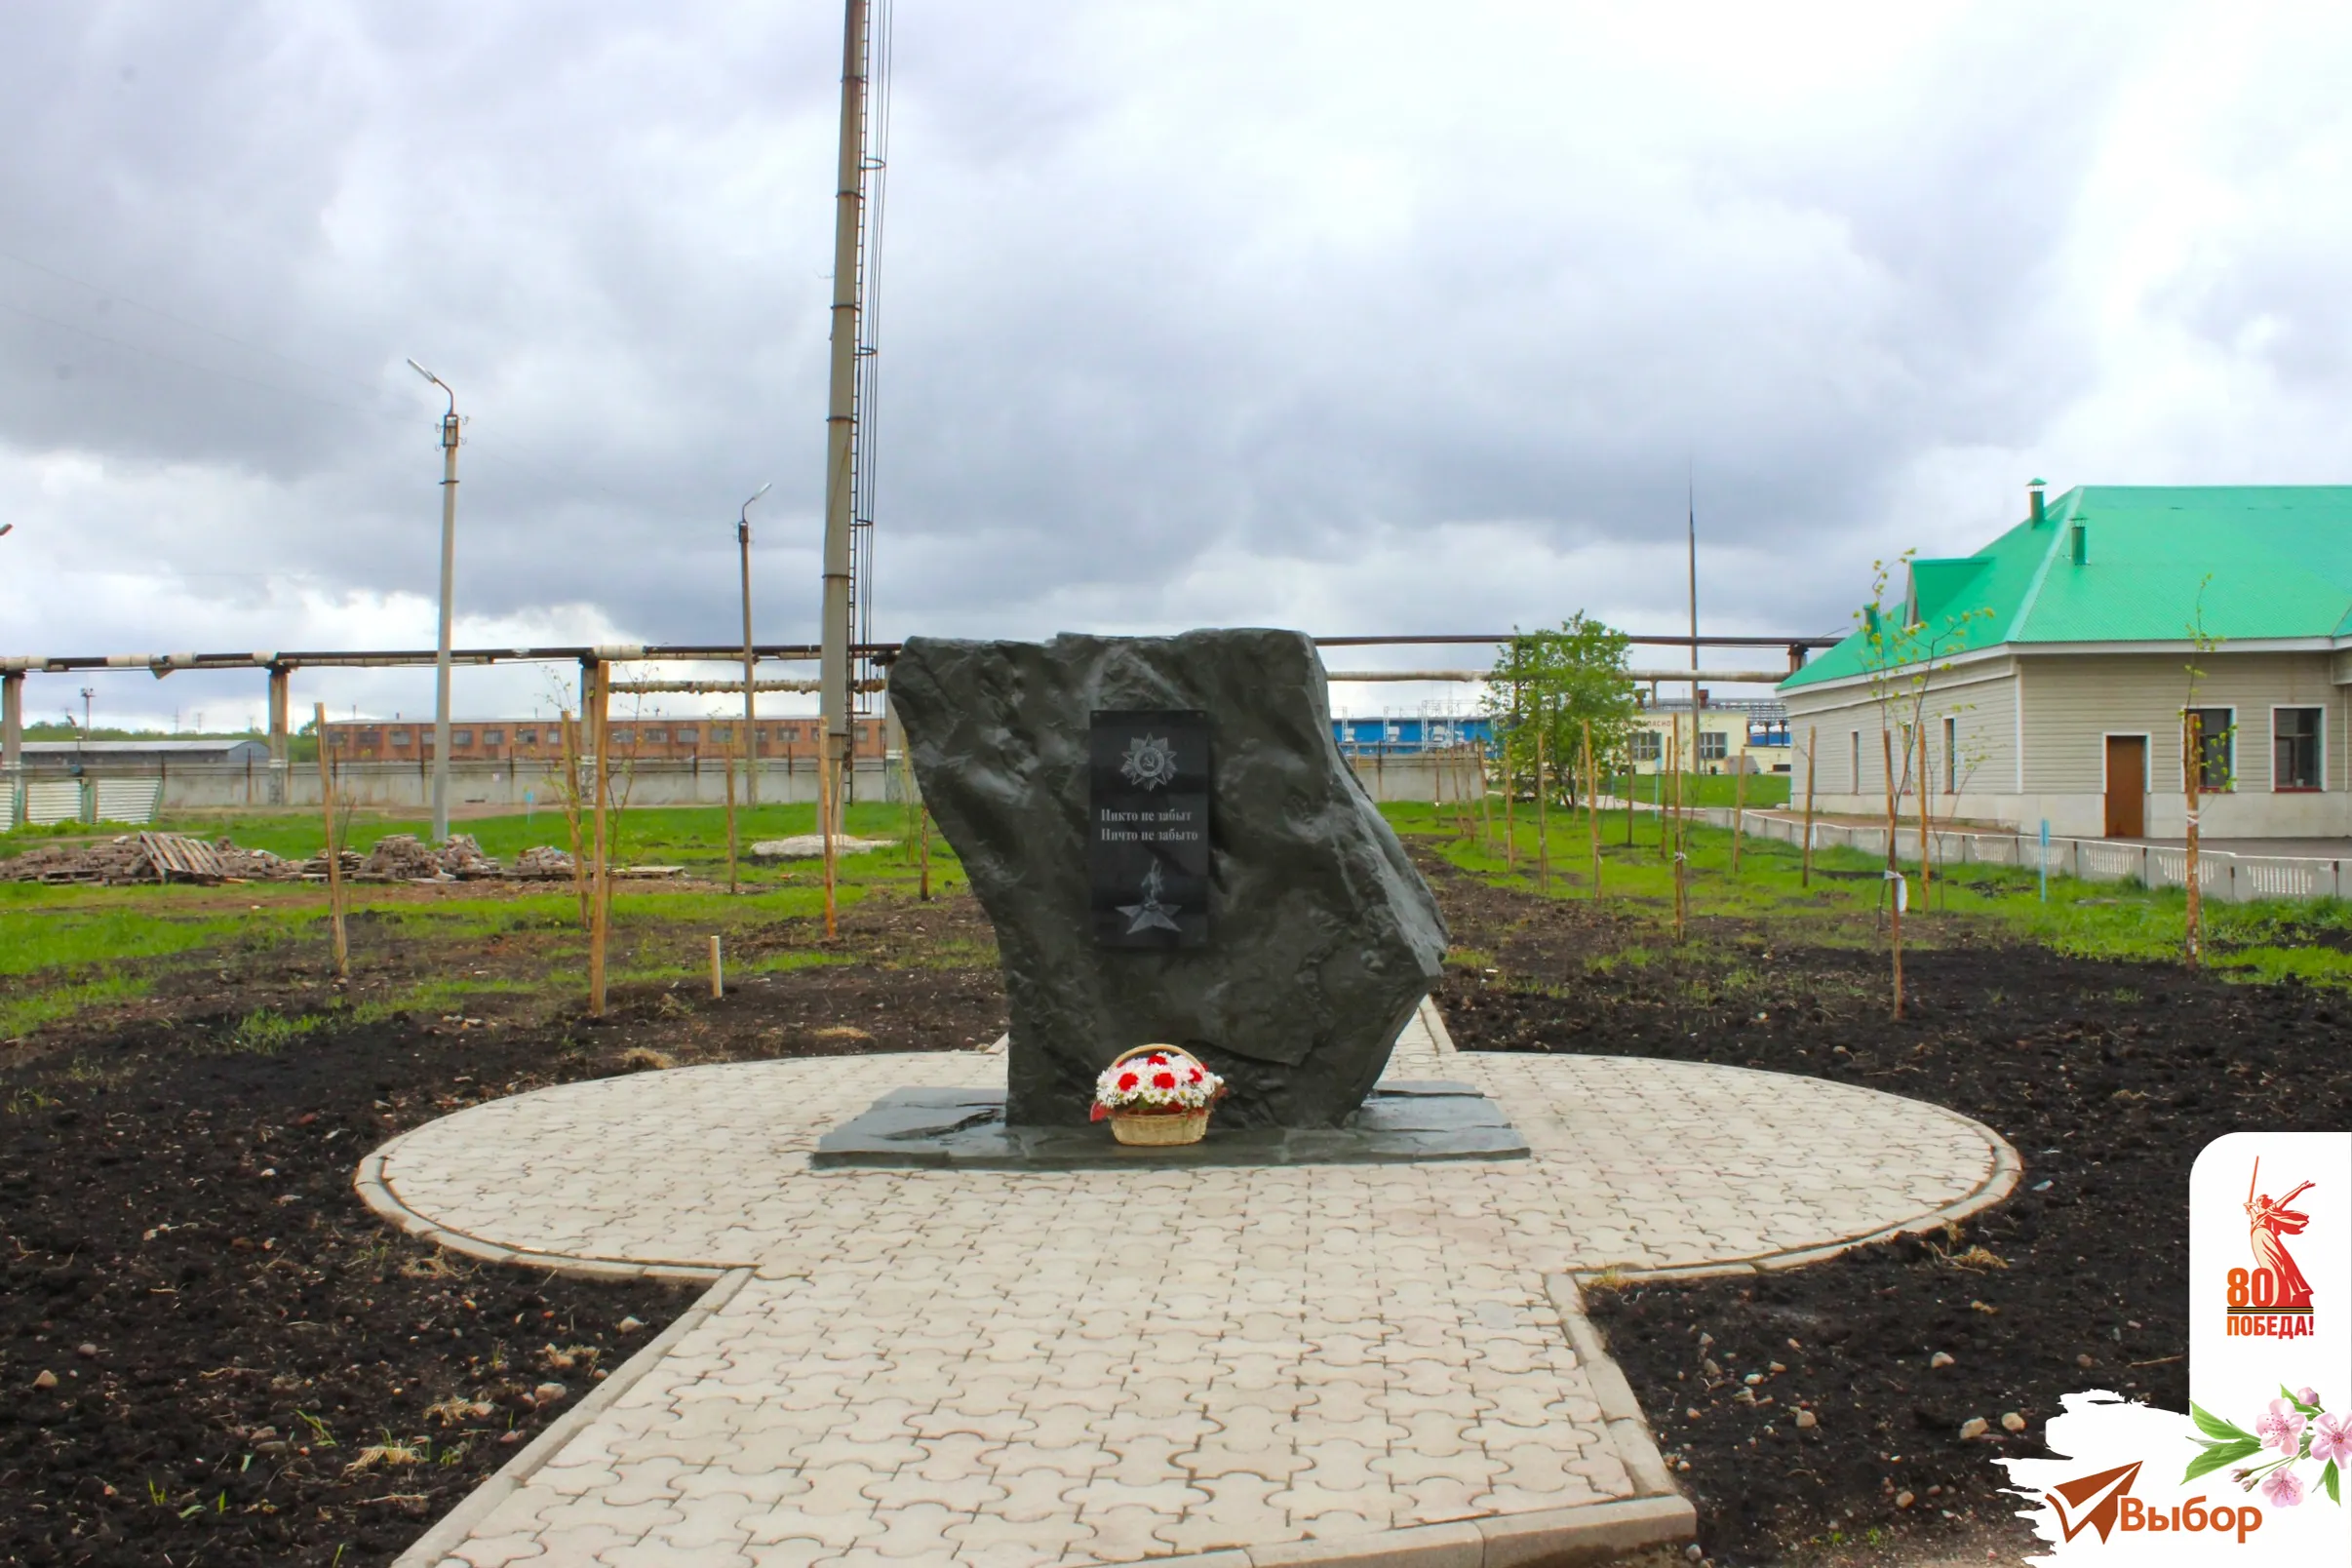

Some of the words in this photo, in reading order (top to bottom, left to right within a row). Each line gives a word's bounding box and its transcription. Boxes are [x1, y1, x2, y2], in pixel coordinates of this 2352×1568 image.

[1101, 808, 1138, 821] Никто
[1141, 811, 1155, 821] не
[1158, 808, 1192, 821] забыт
[1101, 828, 1138, 841] Ничто
[1141, 831, 1155, 841] не
[1158, 827, 1198, 841] забыто
